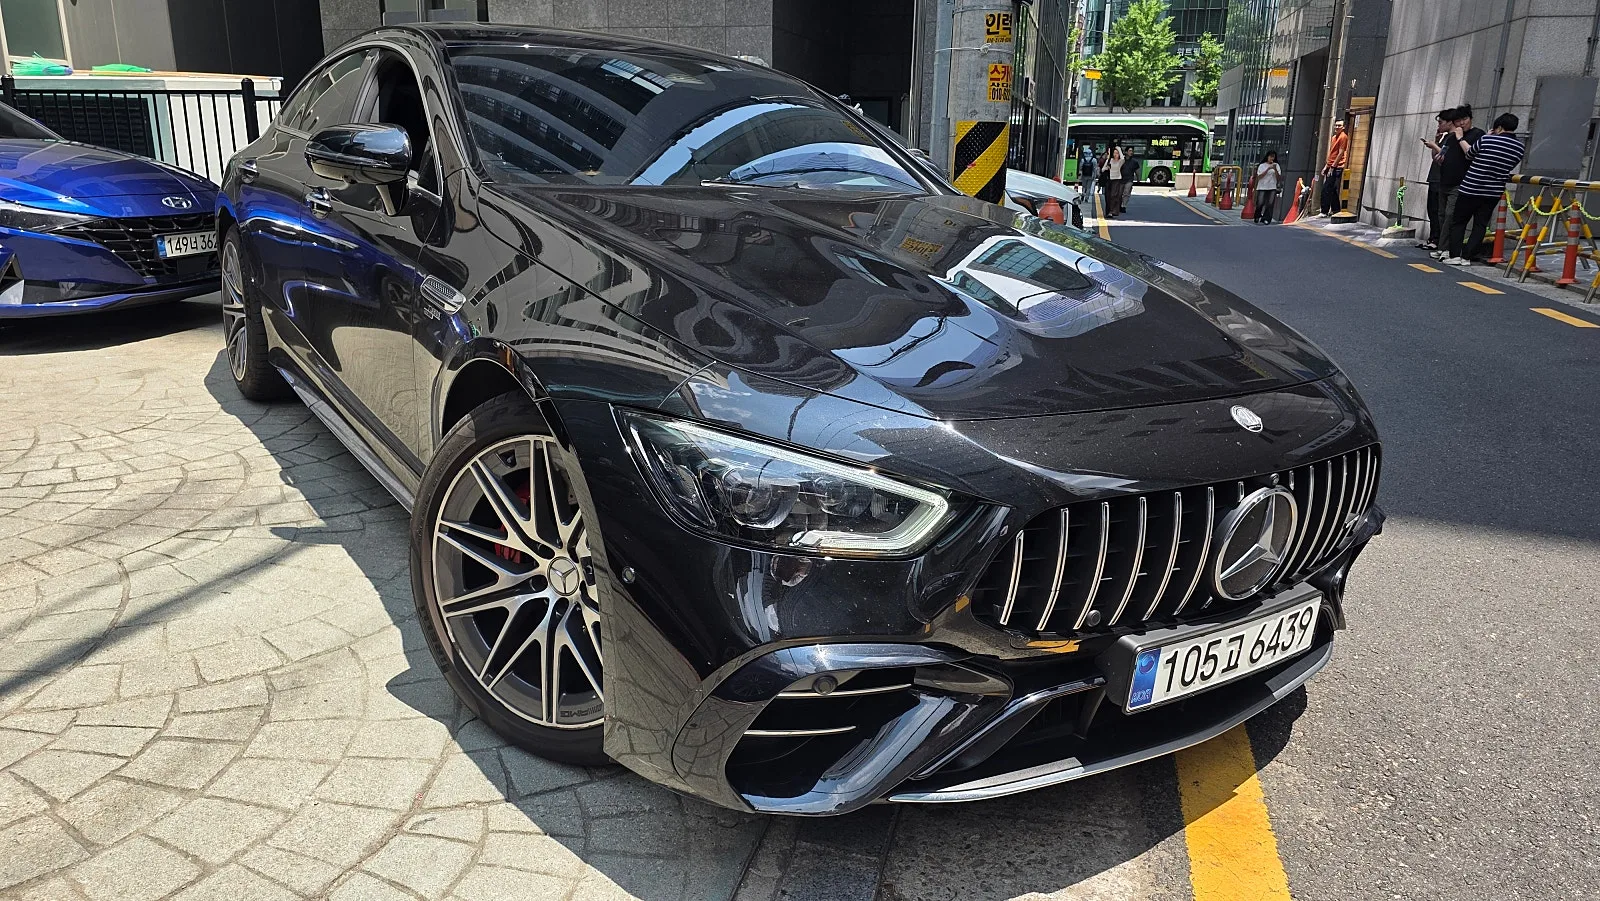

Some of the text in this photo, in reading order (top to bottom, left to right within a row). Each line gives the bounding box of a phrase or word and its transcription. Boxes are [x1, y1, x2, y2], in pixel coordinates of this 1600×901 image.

[986, 13, 1012, 35] 인력
[1165, 606, 1314, 693] 105고 6439
